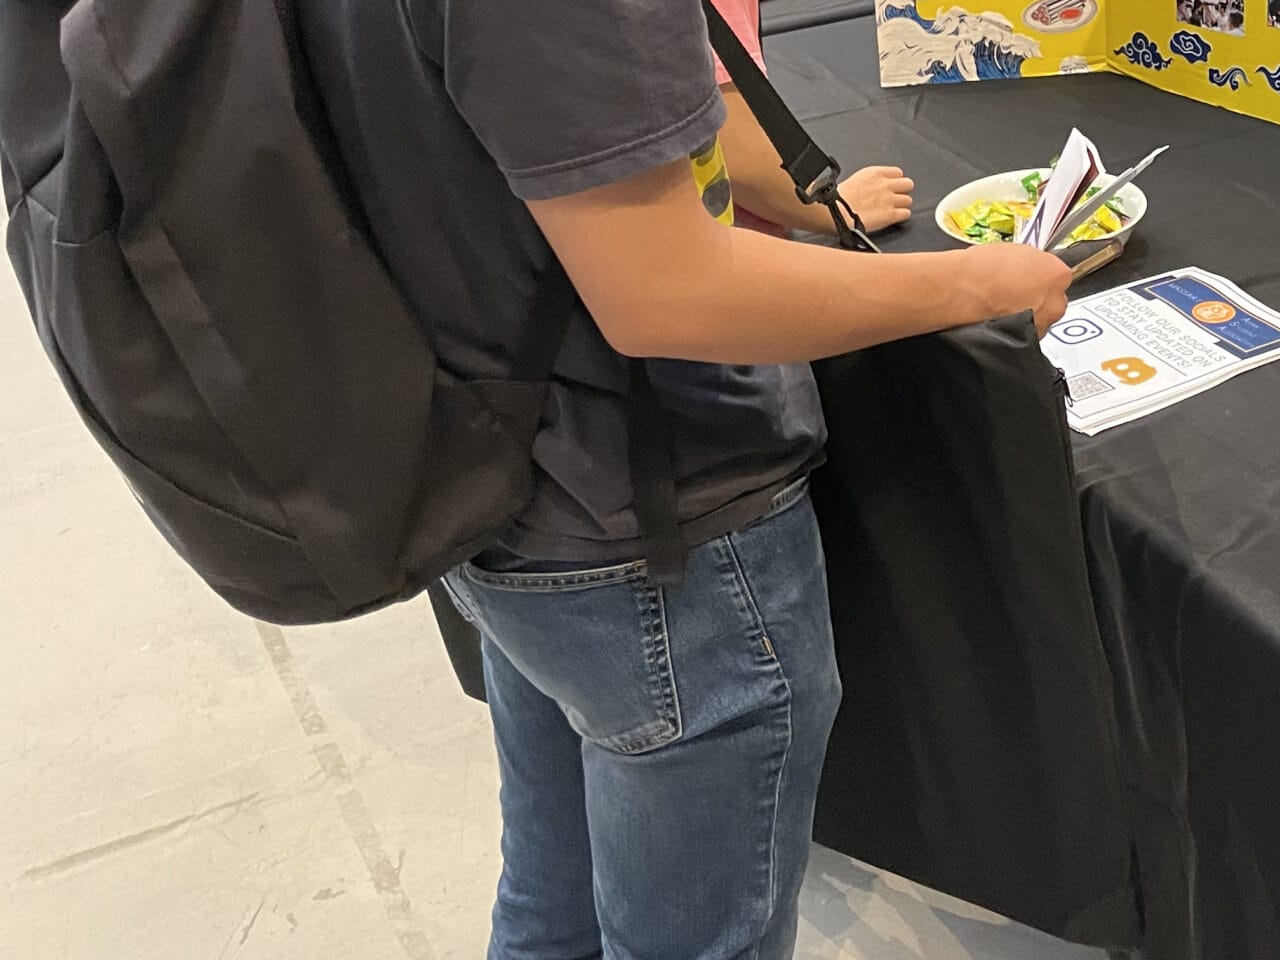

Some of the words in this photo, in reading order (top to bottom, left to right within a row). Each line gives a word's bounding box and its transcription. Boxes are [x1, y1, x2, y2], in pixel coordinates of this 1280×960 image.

[1094, 304, 1148, 340] UPCOMING
[1145, 339, 1192, 369] EVENTS!
[1104, 297, 1120, 308] TO
[1118, 304, 1145, 324] STAY
[1146, 323, 1194, 357] UPDATED
[1192, 354, 1214, 368] ON
[1116, 292, 1160, 318] FOLLOW
[1156, 316, 1180, 335] OUR
[1178, 332, 1226, 363] SOCIALS
